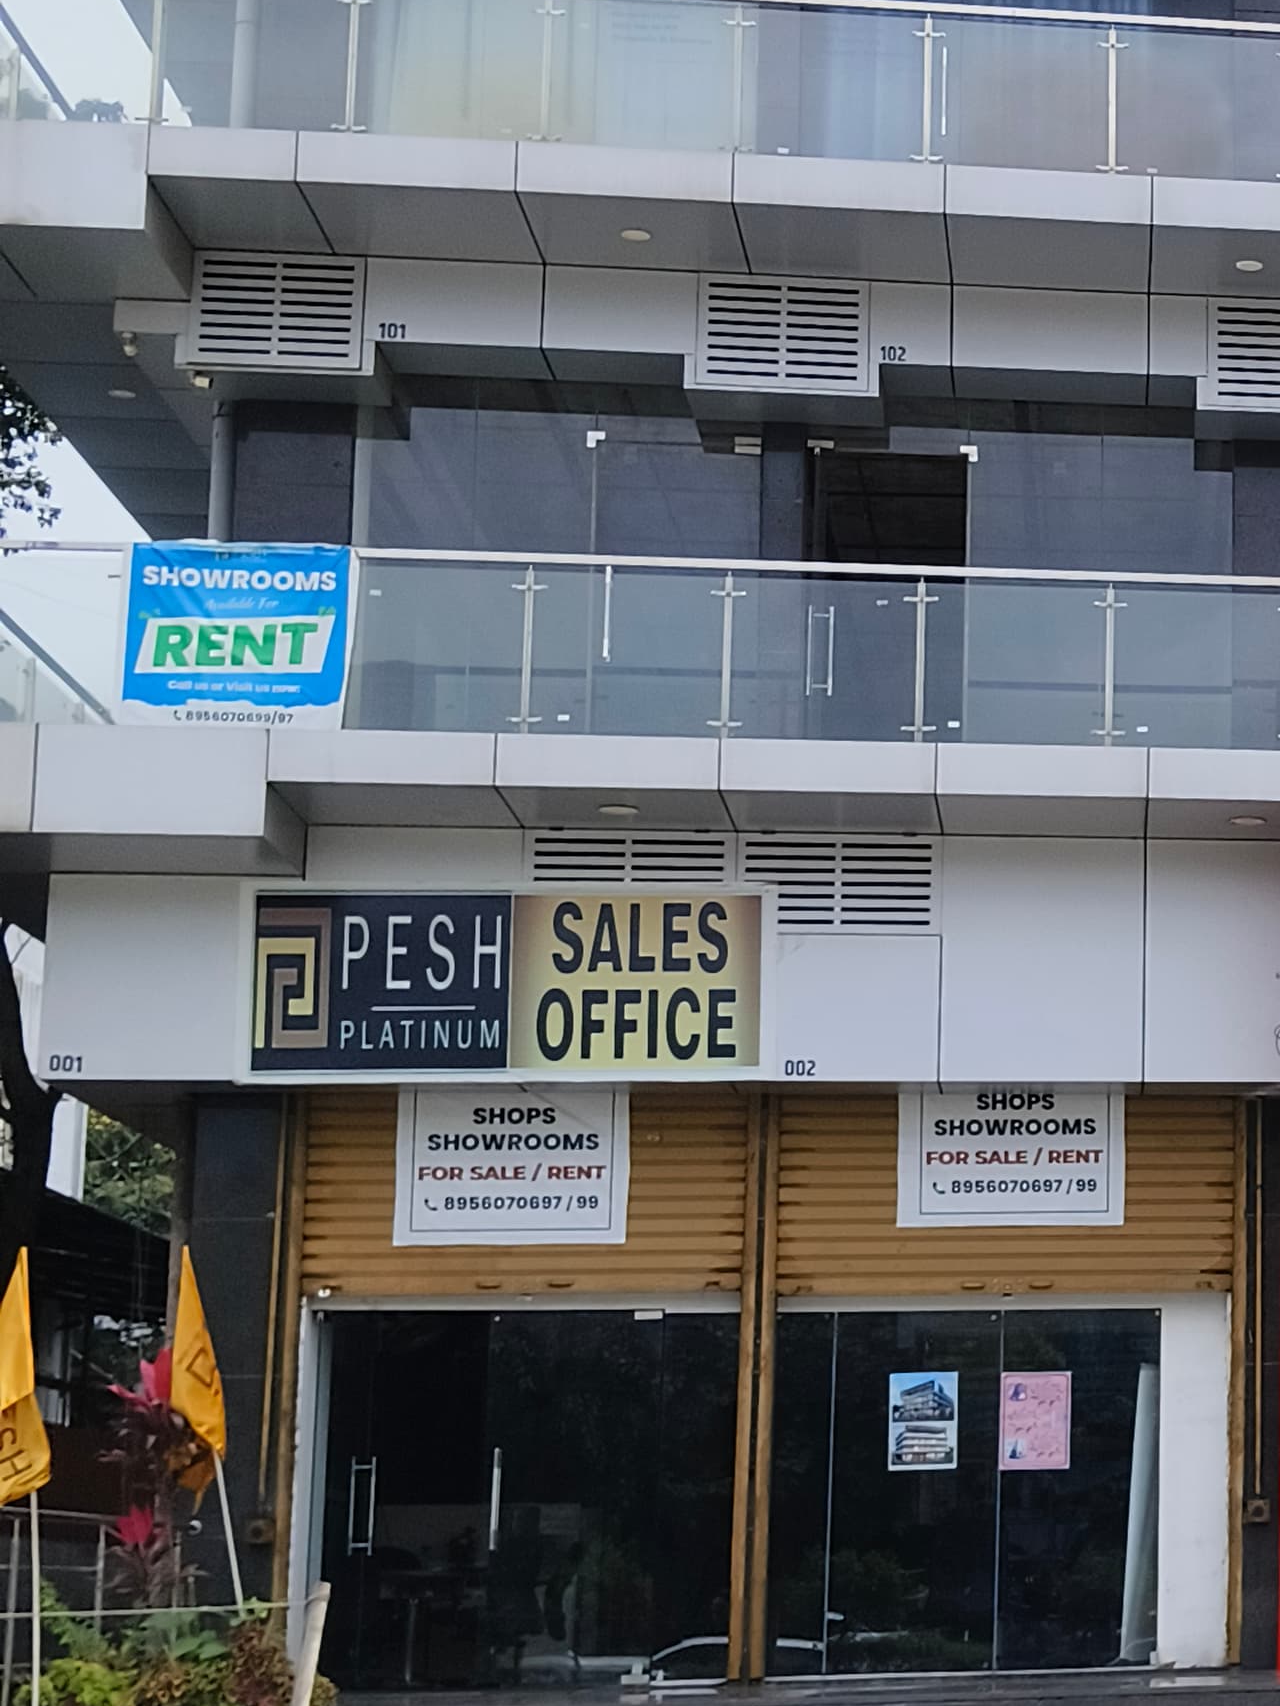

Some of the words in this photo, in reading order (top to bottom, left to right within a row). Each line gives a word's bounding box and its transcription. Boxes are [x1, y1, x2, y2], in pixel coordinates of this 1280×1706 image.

[378, 322, 407, 340] 101
[880, 346, 906, 364] 102
[142, 564, 337, 592] SHOWROOMS
[152, 622, 319, 668] RENT
[551, 901, 729, 974] SALES
[341, 913, 503, 992] PESH
[535, 987, 737, 1062] OFFICE
[340, 1019, 501, 1050] PLATINUM
[49, 1054, 83, 1073] 001
[783, 1060, 816, 1078] 002
[976, 1092, 1055, 1111] SHOPS
[473, 1107, 556, 1125] SHOPS
[934, 1118, 1097, 1136] SHOWROOMS
[427, 1133, 600, 1151] SHOWROOMS
[926, 1150, 969, 1165] FOR
[975, 1150, 1028, 1165] SALE
[1032, 1147, 1044, 1166] /
[1048, 1149, 1104, 1164] RENT
[418, 1166, 464, 1181] FOR
[470, 1165, 526, 1181] SALE
[531, 1163, 543, 1182] /
[547, 1164, 607, 1181] RENT
[951, 1179, 1063, 1194] 8956070697
[1076, 1178, 1098, 1192] 99
[444, 1195, 562, 1211] 8956070697
[577, 1195, 599, 1209] 99
